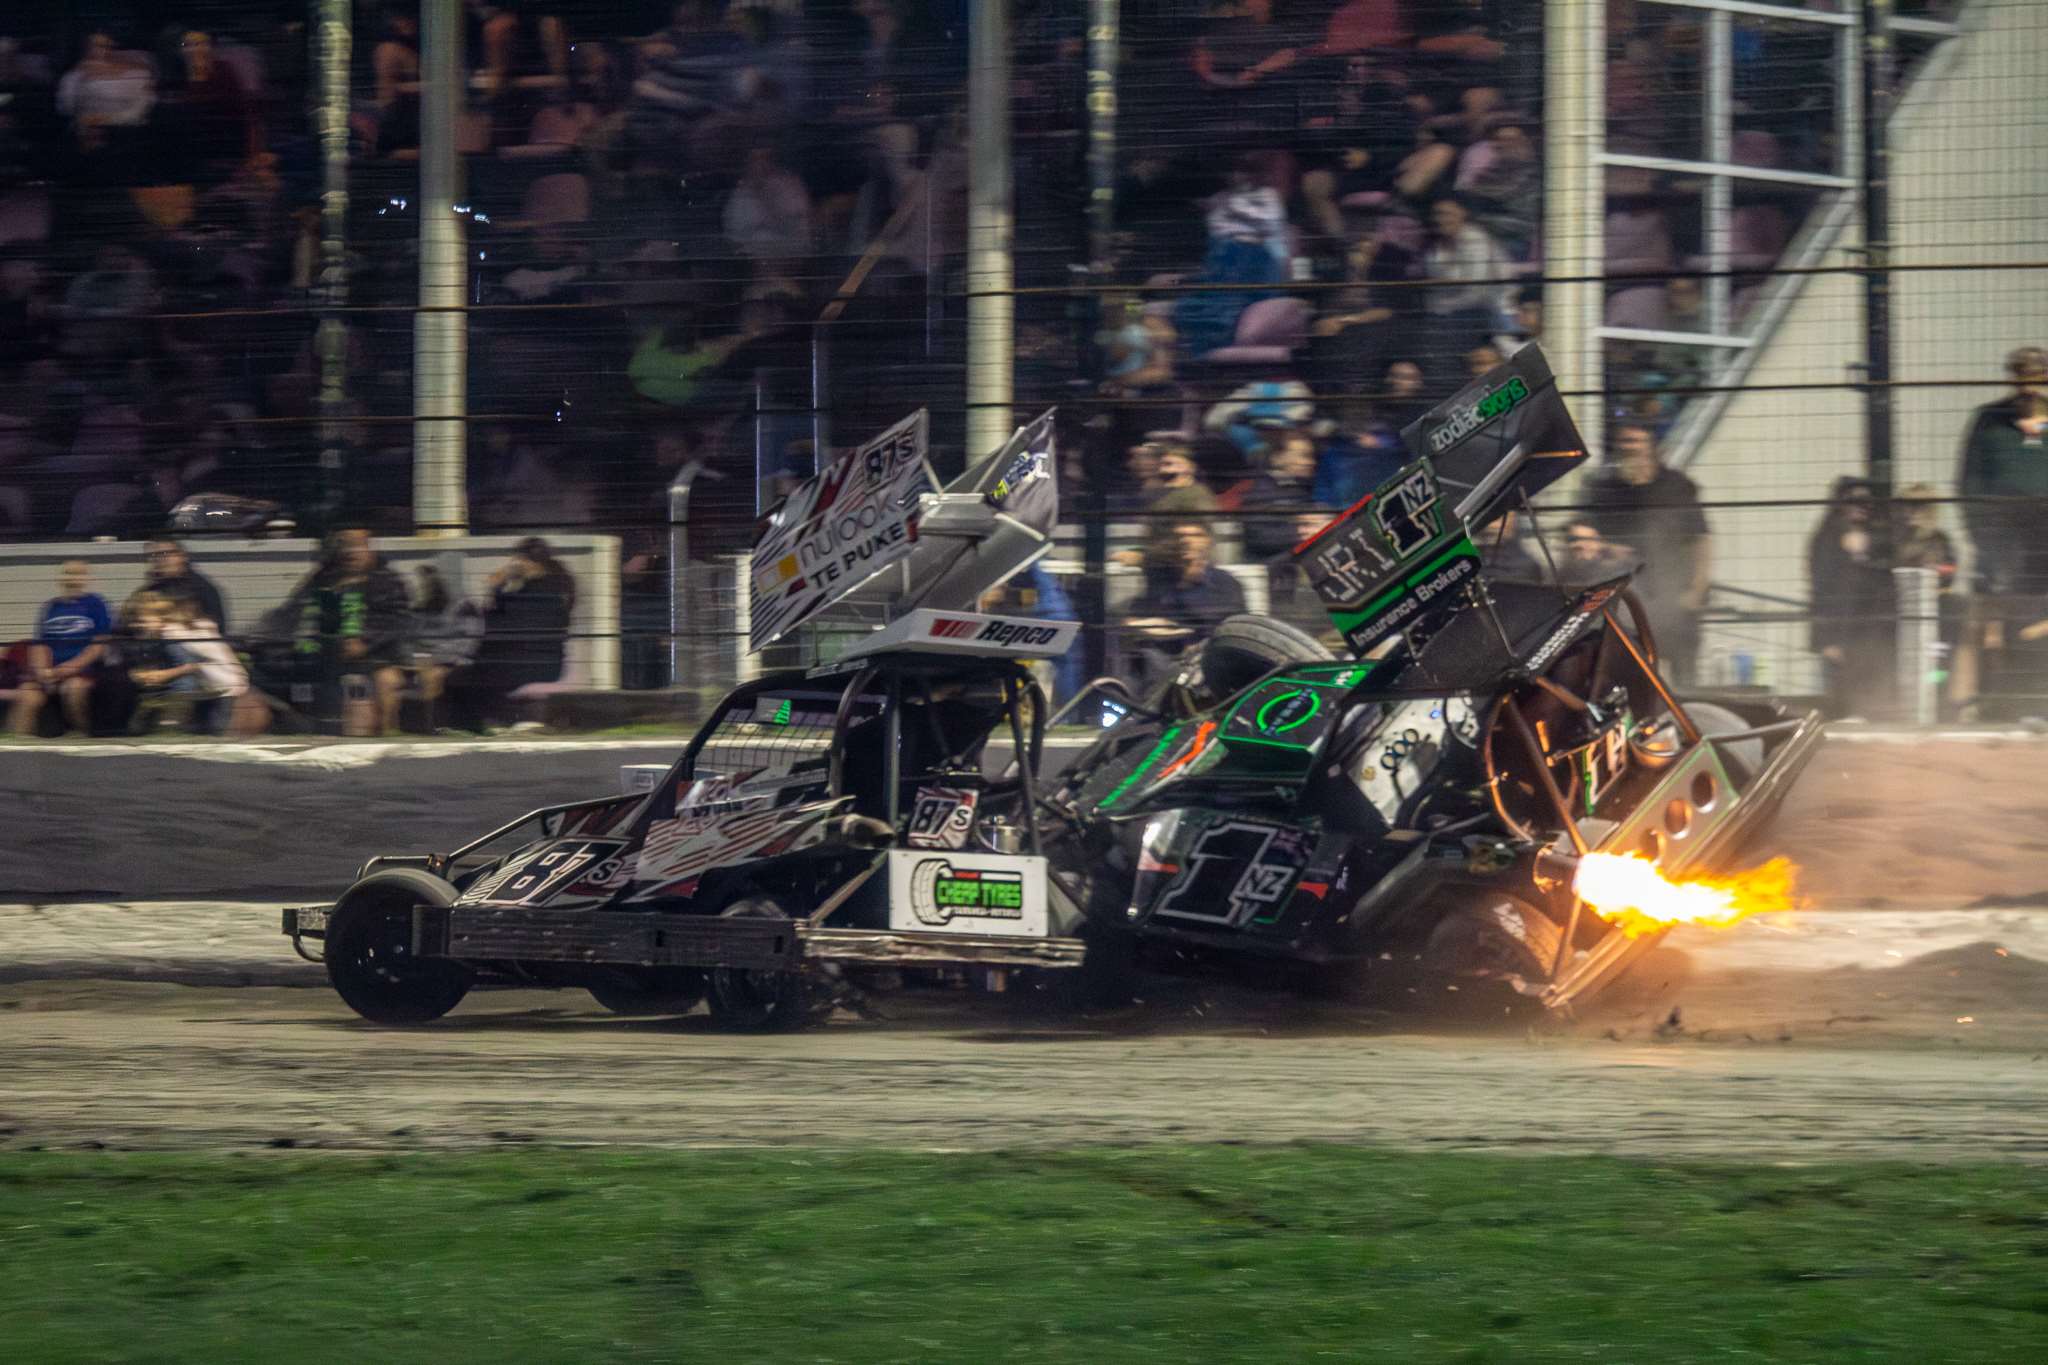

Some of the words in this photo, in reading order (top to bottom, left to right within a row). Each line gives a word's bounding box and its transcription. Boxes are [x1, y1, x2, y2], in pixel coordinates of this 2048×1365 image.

[810, 561, 840, 589] TE
[841, 521, 906, 571] PUKE
[1352, 598, 1418, 648] Insurance
[1414, 558, 1472, 602] Brokers
[976, 620, 1059, 646] Repco
[936, 879, 980, 906] CHEAP
[981, 881, 1022, 909] TYRES
